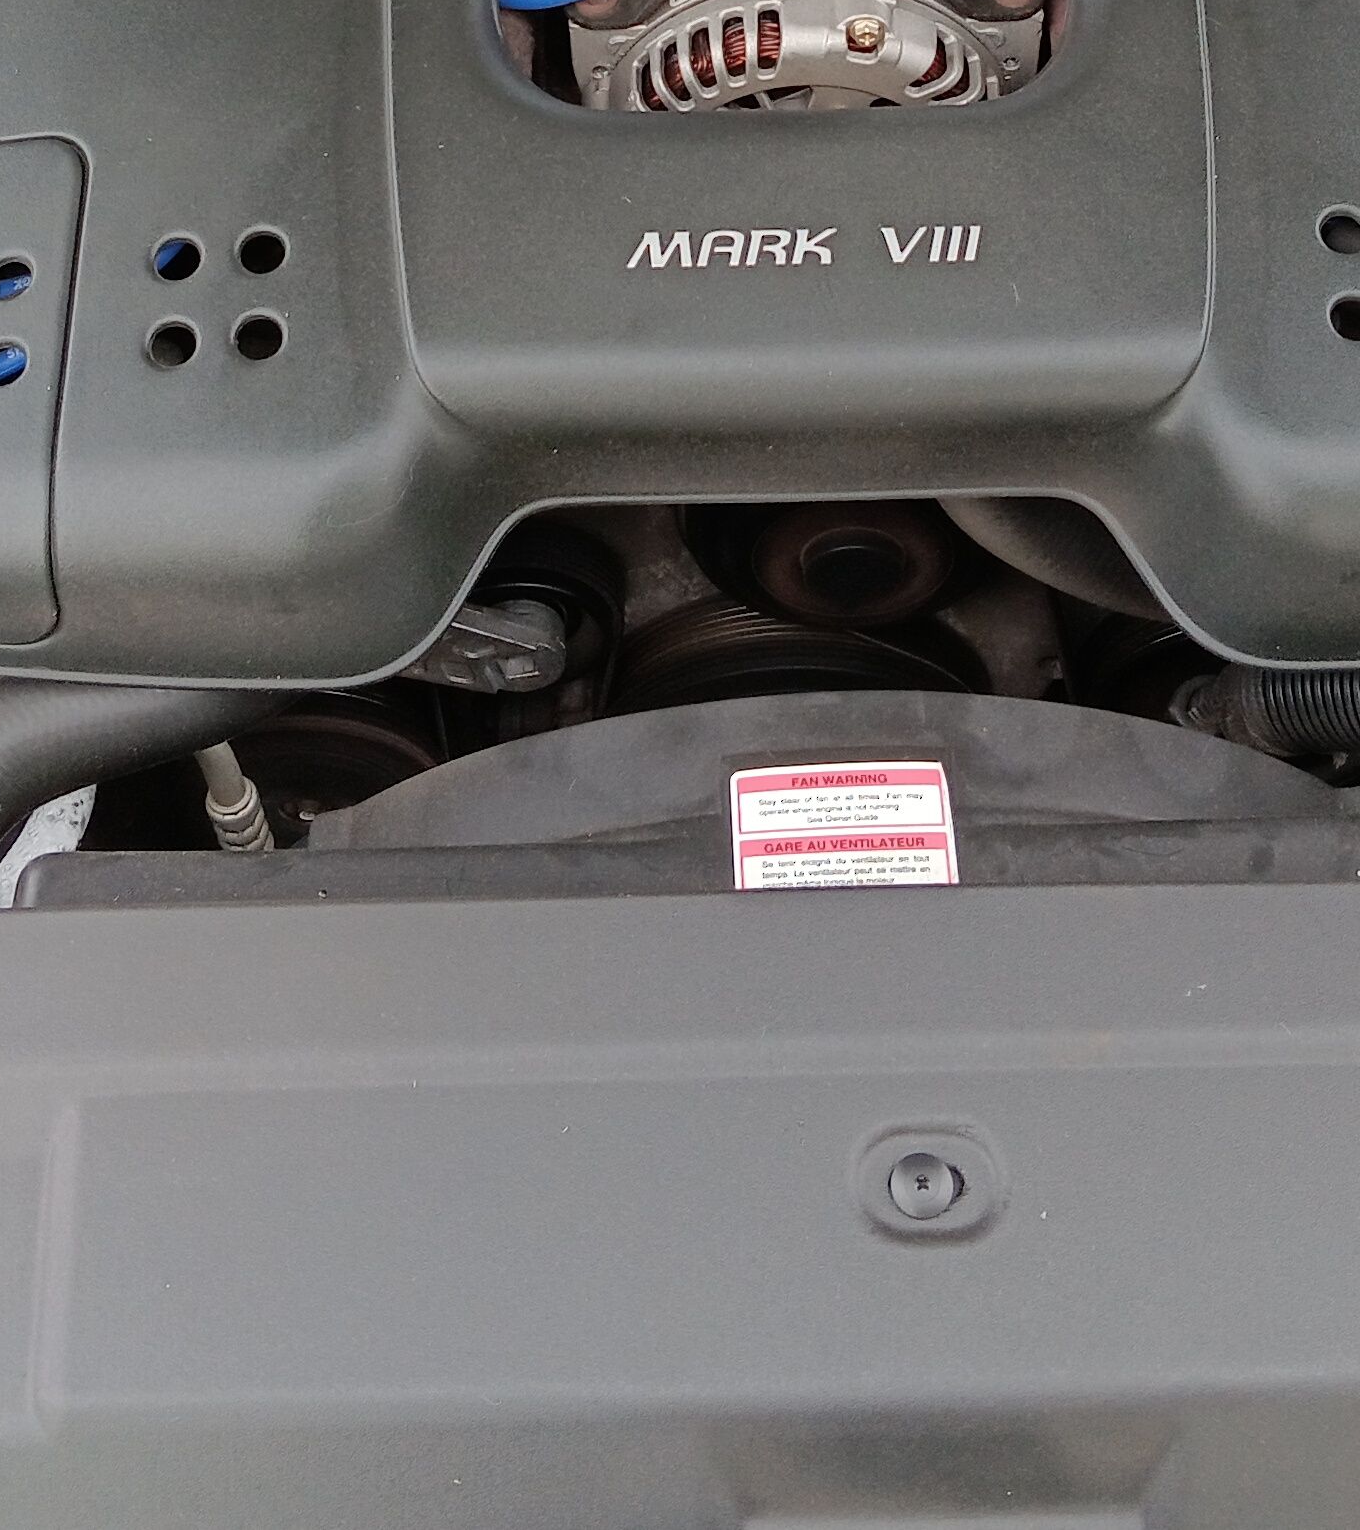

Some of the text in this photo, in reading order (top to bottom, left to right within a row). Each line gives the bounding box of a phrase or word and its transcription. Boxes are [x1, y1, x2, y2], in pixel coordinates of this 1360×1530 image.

[626, 224, 981, 268] MARK VIII
[791, 773, 888, 788] FAN WARNING
[763, 836, 926, 853] GARE AU VENTILATEUR
